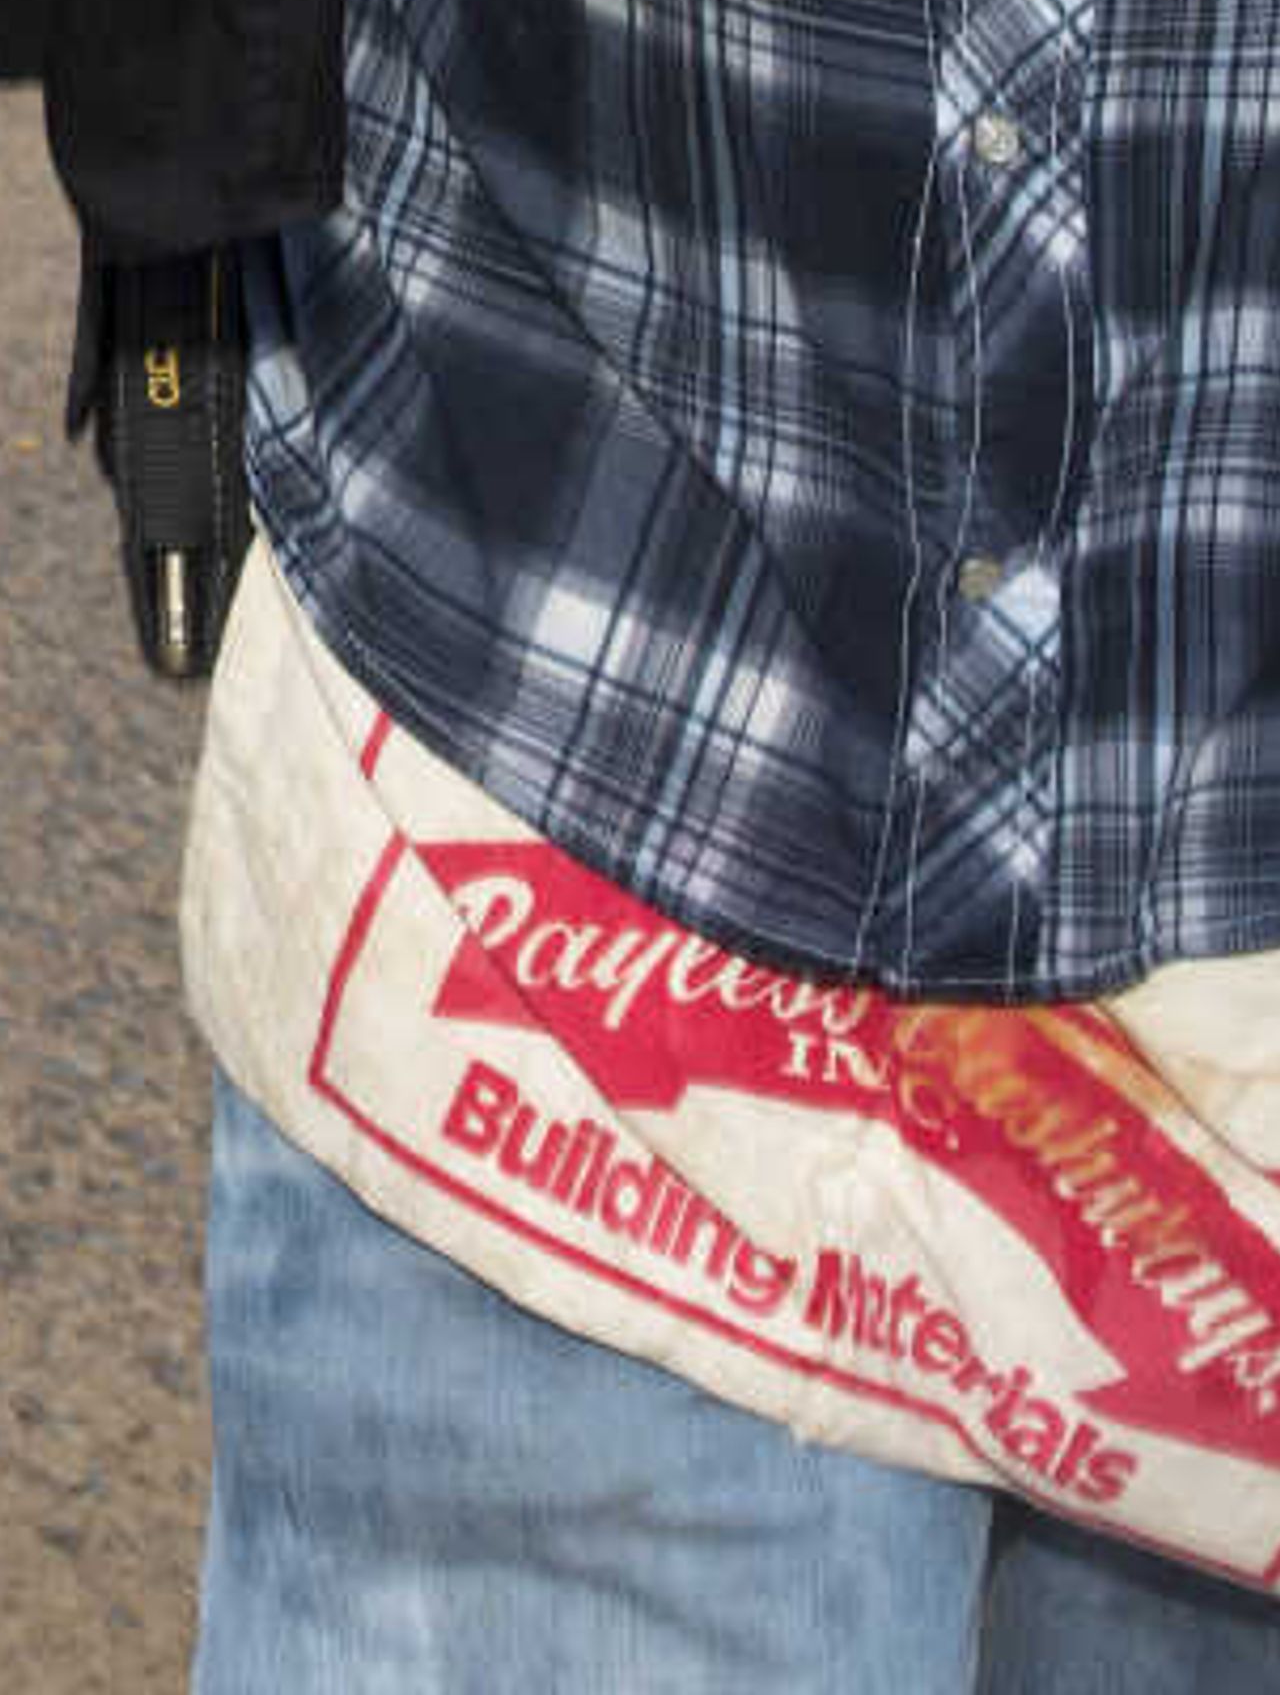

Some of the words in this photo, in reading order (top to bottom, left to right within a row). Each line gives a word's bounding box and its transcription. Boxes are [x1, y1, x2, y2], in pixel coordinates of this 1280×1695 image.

[450, 875, 872, 1031] Payless
[440, 1059, 798, 1319] Building
[804, 1247, 1138, 1502] Materials
